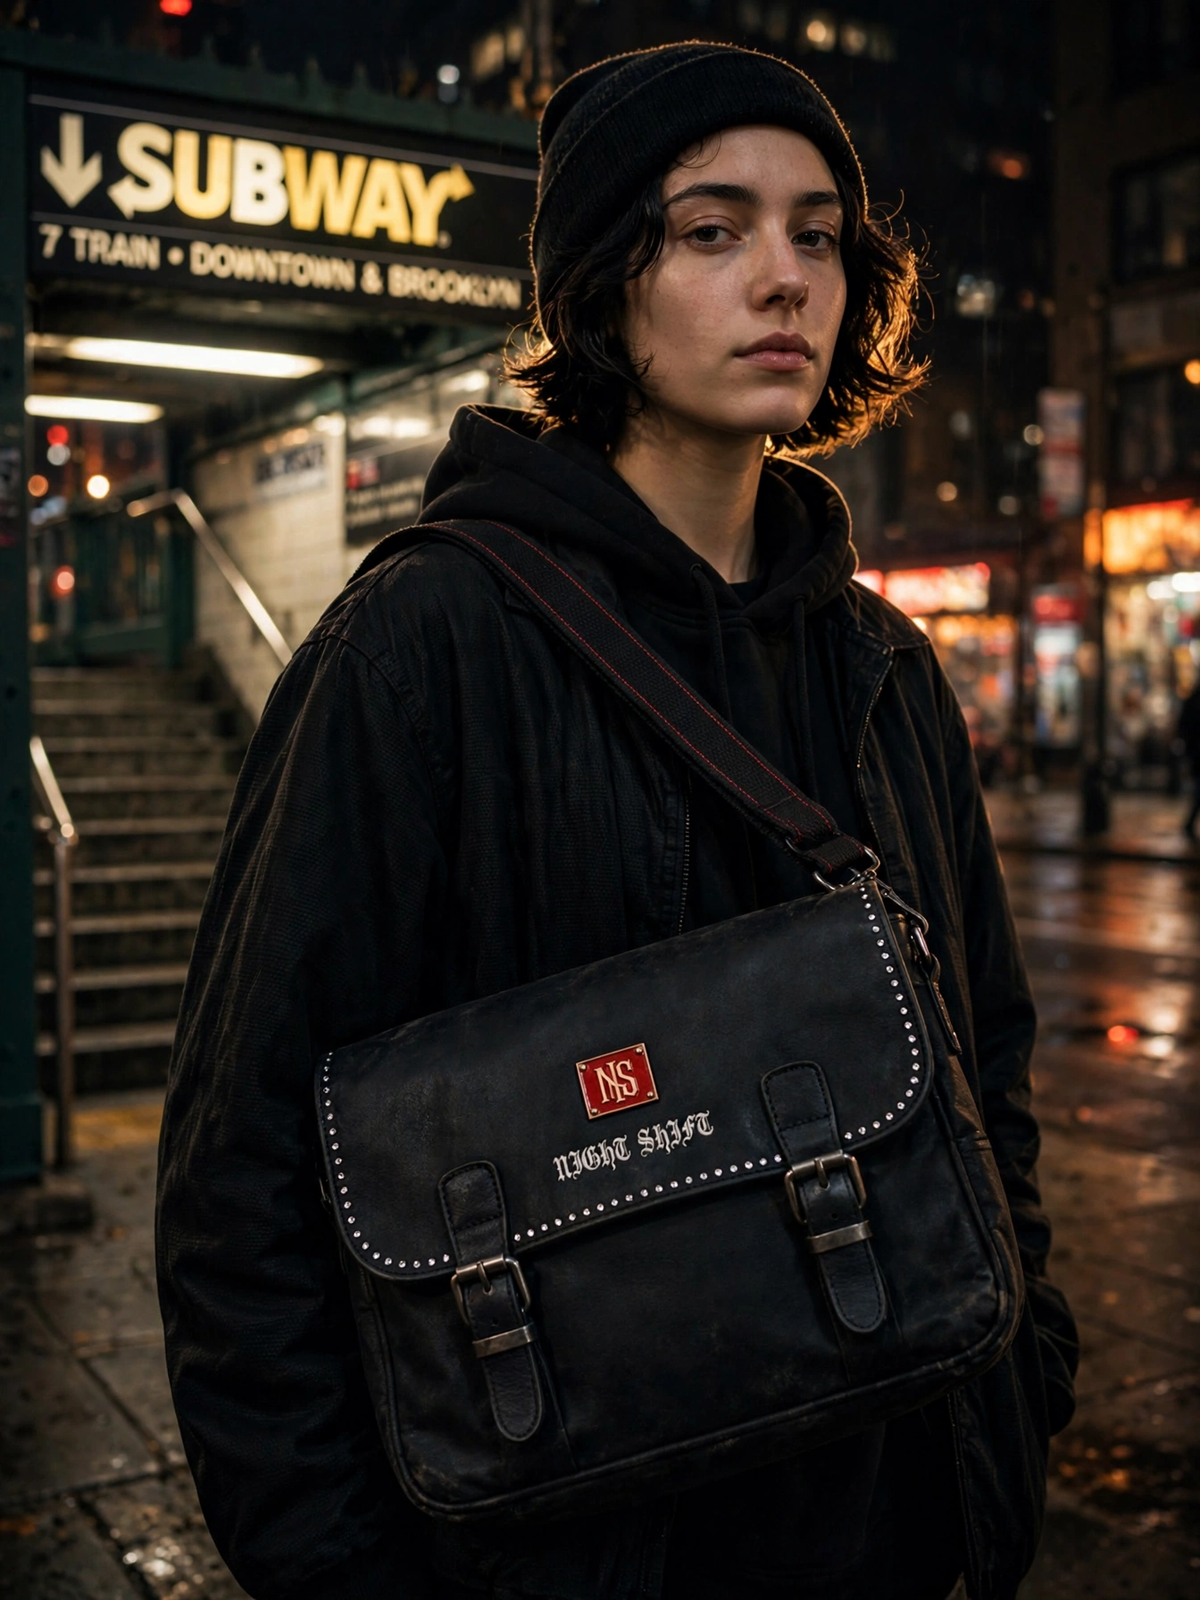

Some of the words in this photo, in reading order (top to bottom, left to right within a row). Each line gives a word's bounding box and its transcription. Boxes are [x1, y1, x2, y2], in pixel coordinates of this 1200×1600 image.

[108, 122, 474, 247] SUBWAY
[39, 223, 63, 259] 7
[69, 227, 160, 270] TRAIN
[190, 241, 355, 292] DOWNTOWN
[361, 261, 383, 295] &
[388, 263, 521, 310] BROOKLYN
[594, 1059, 639, 1103] NS
